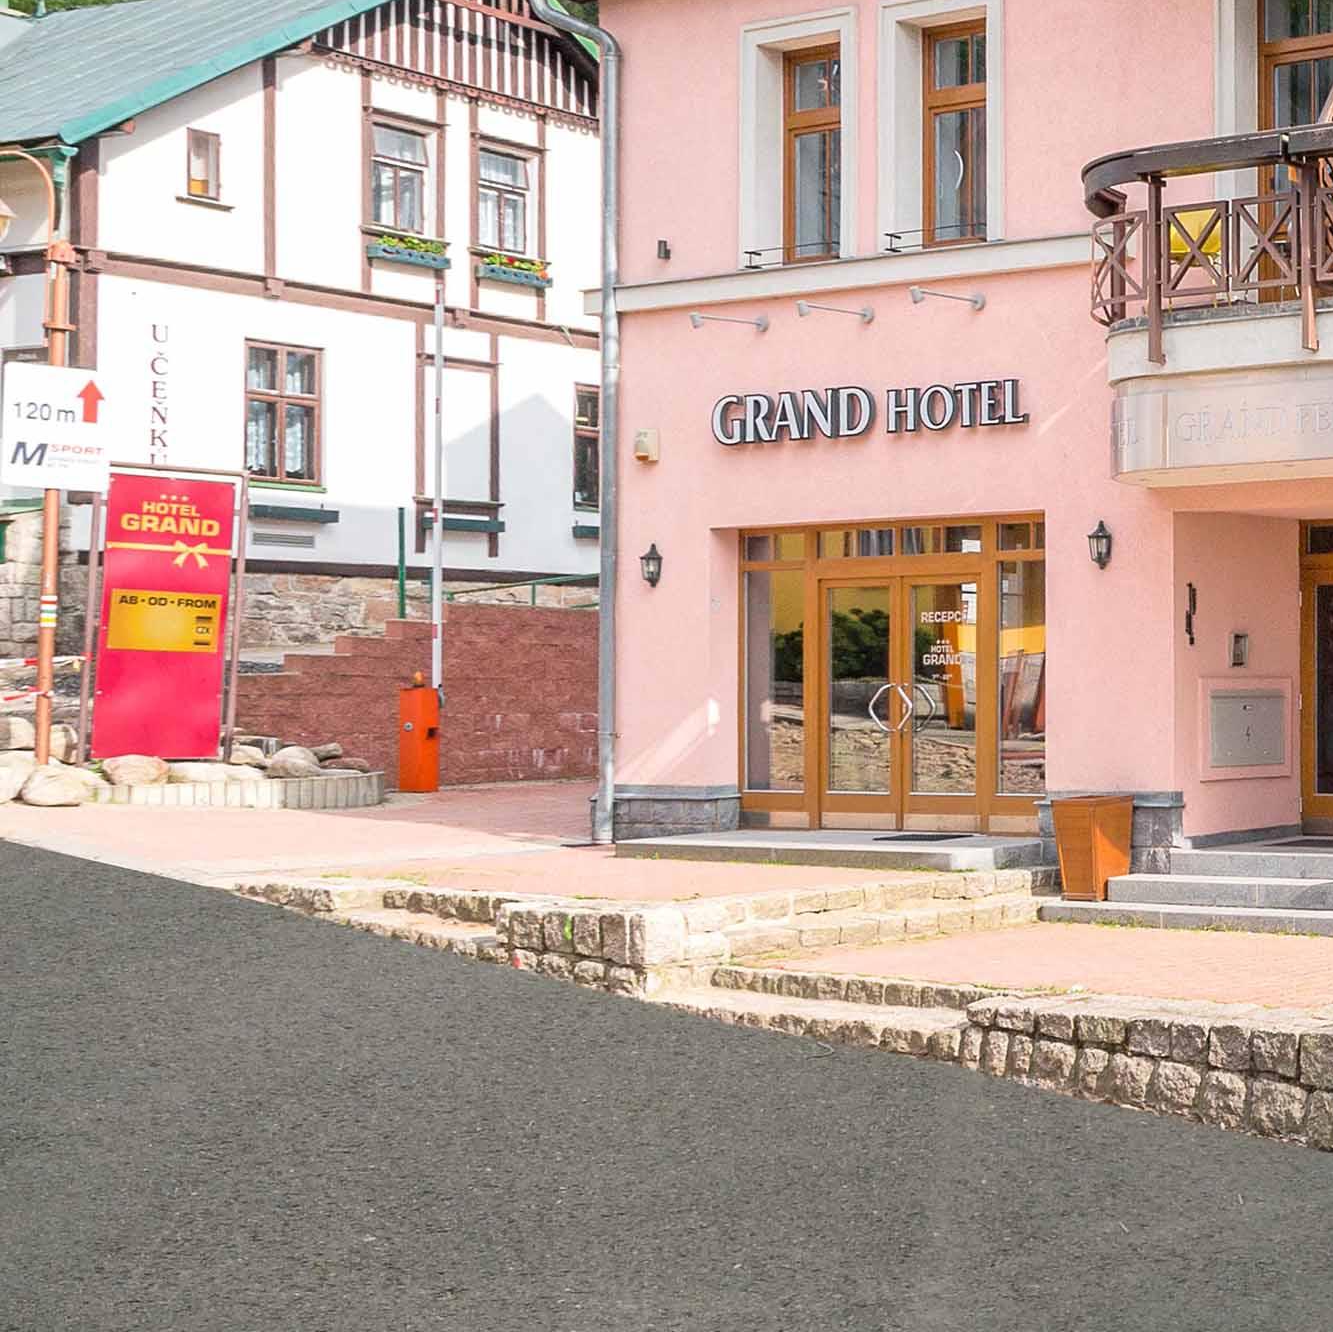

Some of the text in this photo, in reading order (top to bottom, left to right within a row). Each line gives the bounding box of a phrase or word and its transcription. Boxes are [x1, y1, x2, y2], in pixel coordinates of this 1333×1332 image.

[14, 402, 76, 423] 120 m
[711, 379, 1029, 446] GRAND HOTEL
[10, 441, 103, 466] M SPORT
[142, 501, 200, 517] HOTEL
[120, 513, 220, 537] GRAND
[118, 595, 216, 609] AB OD FROM
[931, 644, 954, 653] HOTEL
